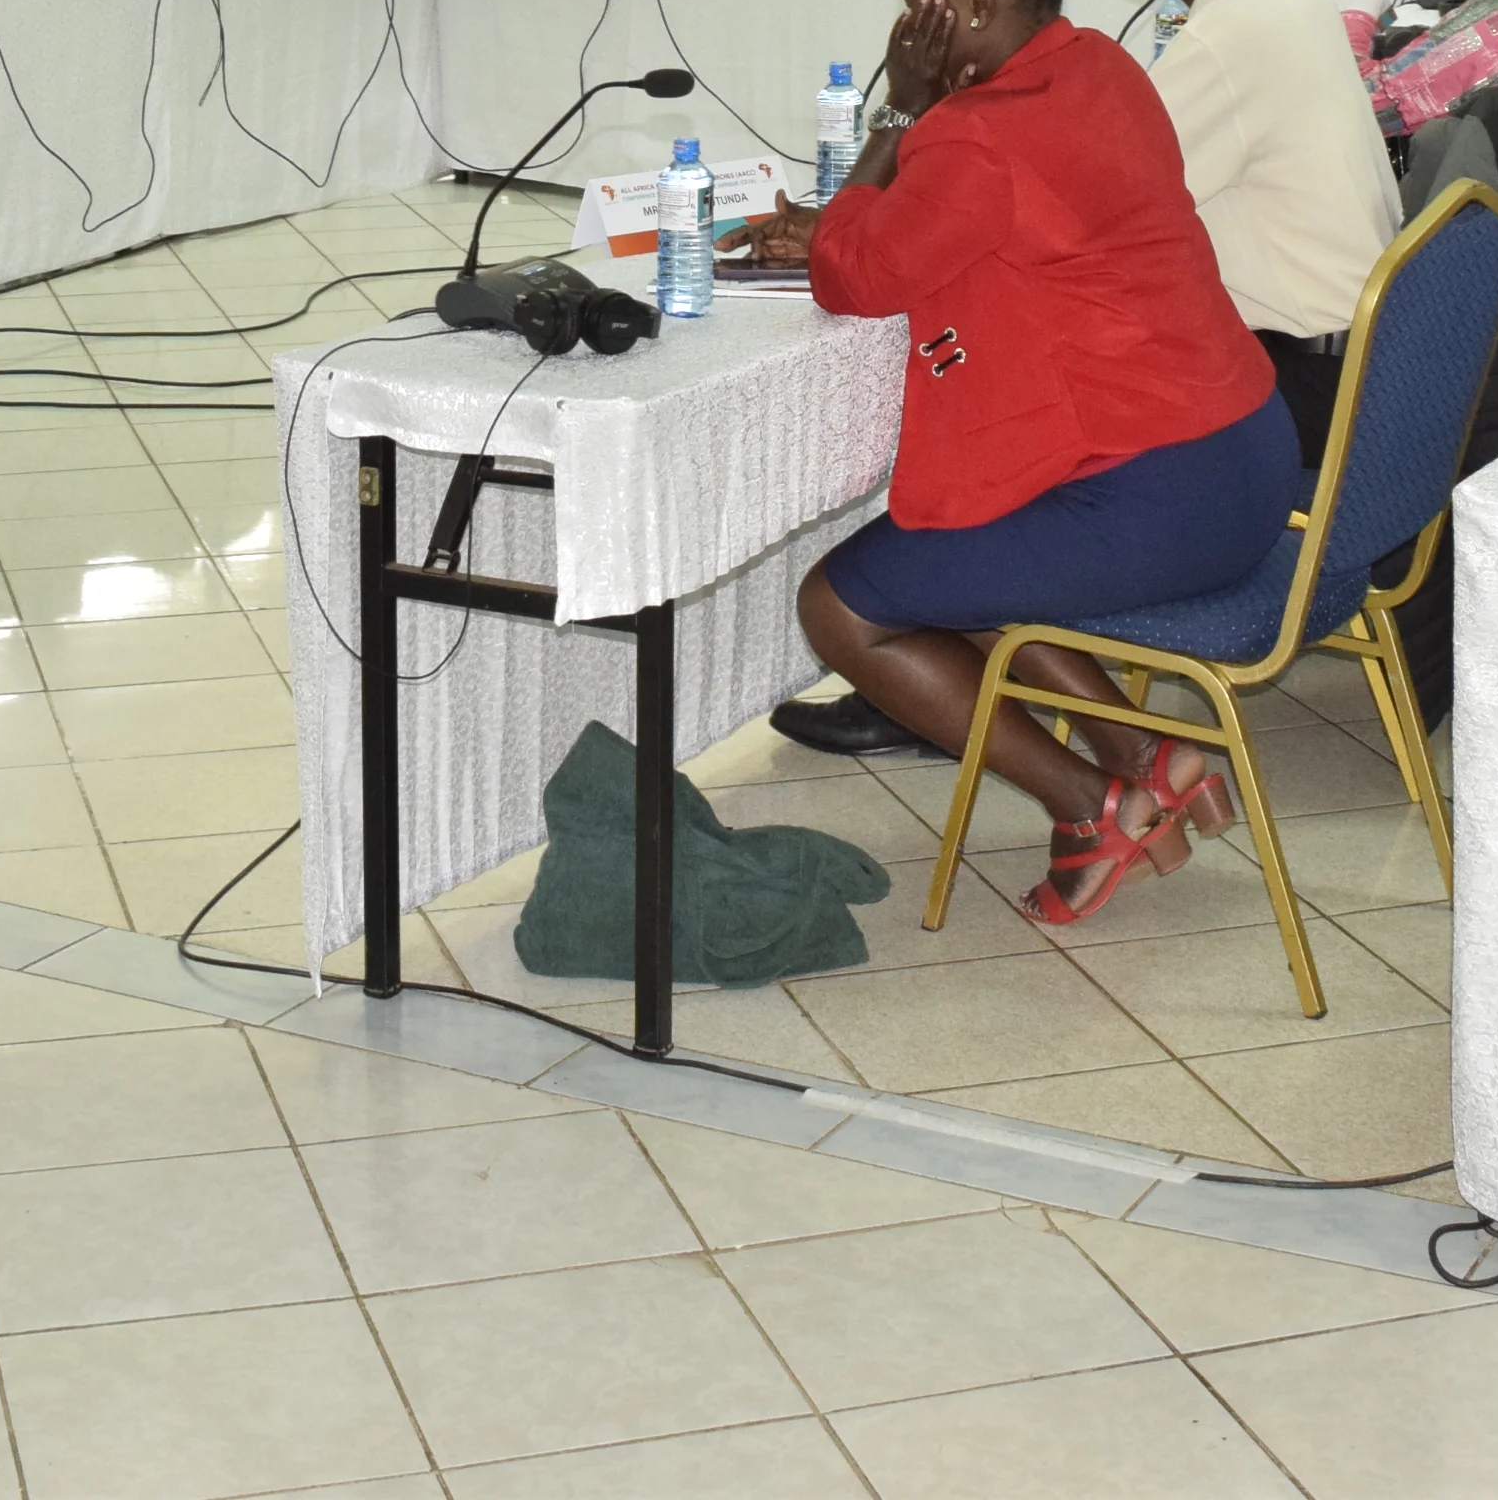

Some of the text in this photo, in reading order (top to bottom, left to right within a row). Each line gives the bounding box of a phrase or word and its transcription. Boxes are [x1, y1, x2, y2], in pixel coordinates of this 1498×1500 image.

[620, 186, 632, 194] ALL
[633, 184, 655, 193] AFRICA
[712, 193, 749, 206] TUNDA
